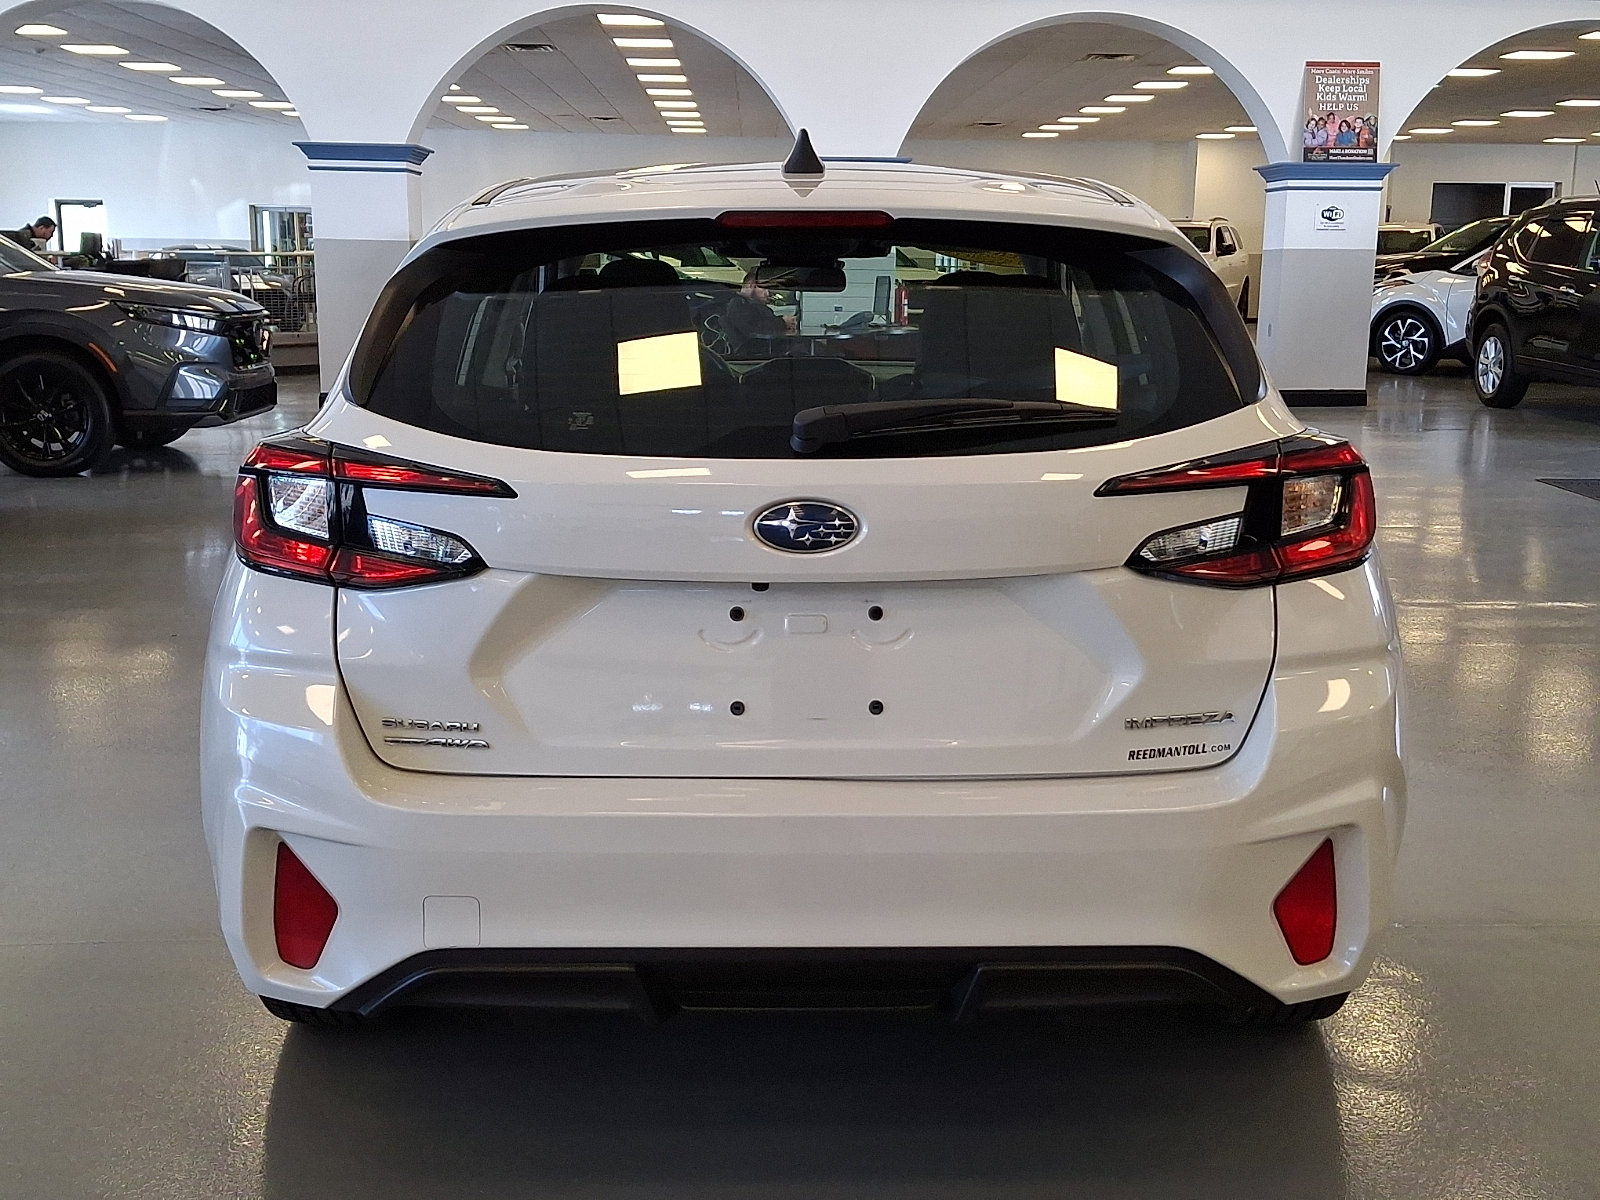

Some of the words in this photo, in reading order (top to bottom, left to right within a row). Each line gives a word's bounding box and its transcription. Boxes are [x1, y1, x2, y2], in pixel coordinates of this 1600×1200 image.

[1315, 75, 1370, 85] Dealerships
[1318, 84, 1341, 94] Keep
[1342, 84, 1367, 93] Local
[1316, 92, 1337, 101] Kids
[1338, 92, 1368, 101] Warm!
[1319, 103, 1345, 111] HELP
[1346, 103, 1359, 111] US
[381, 717, 480, 732] SUBARU
[1124, 711, 1234, 730] IMPREZA
